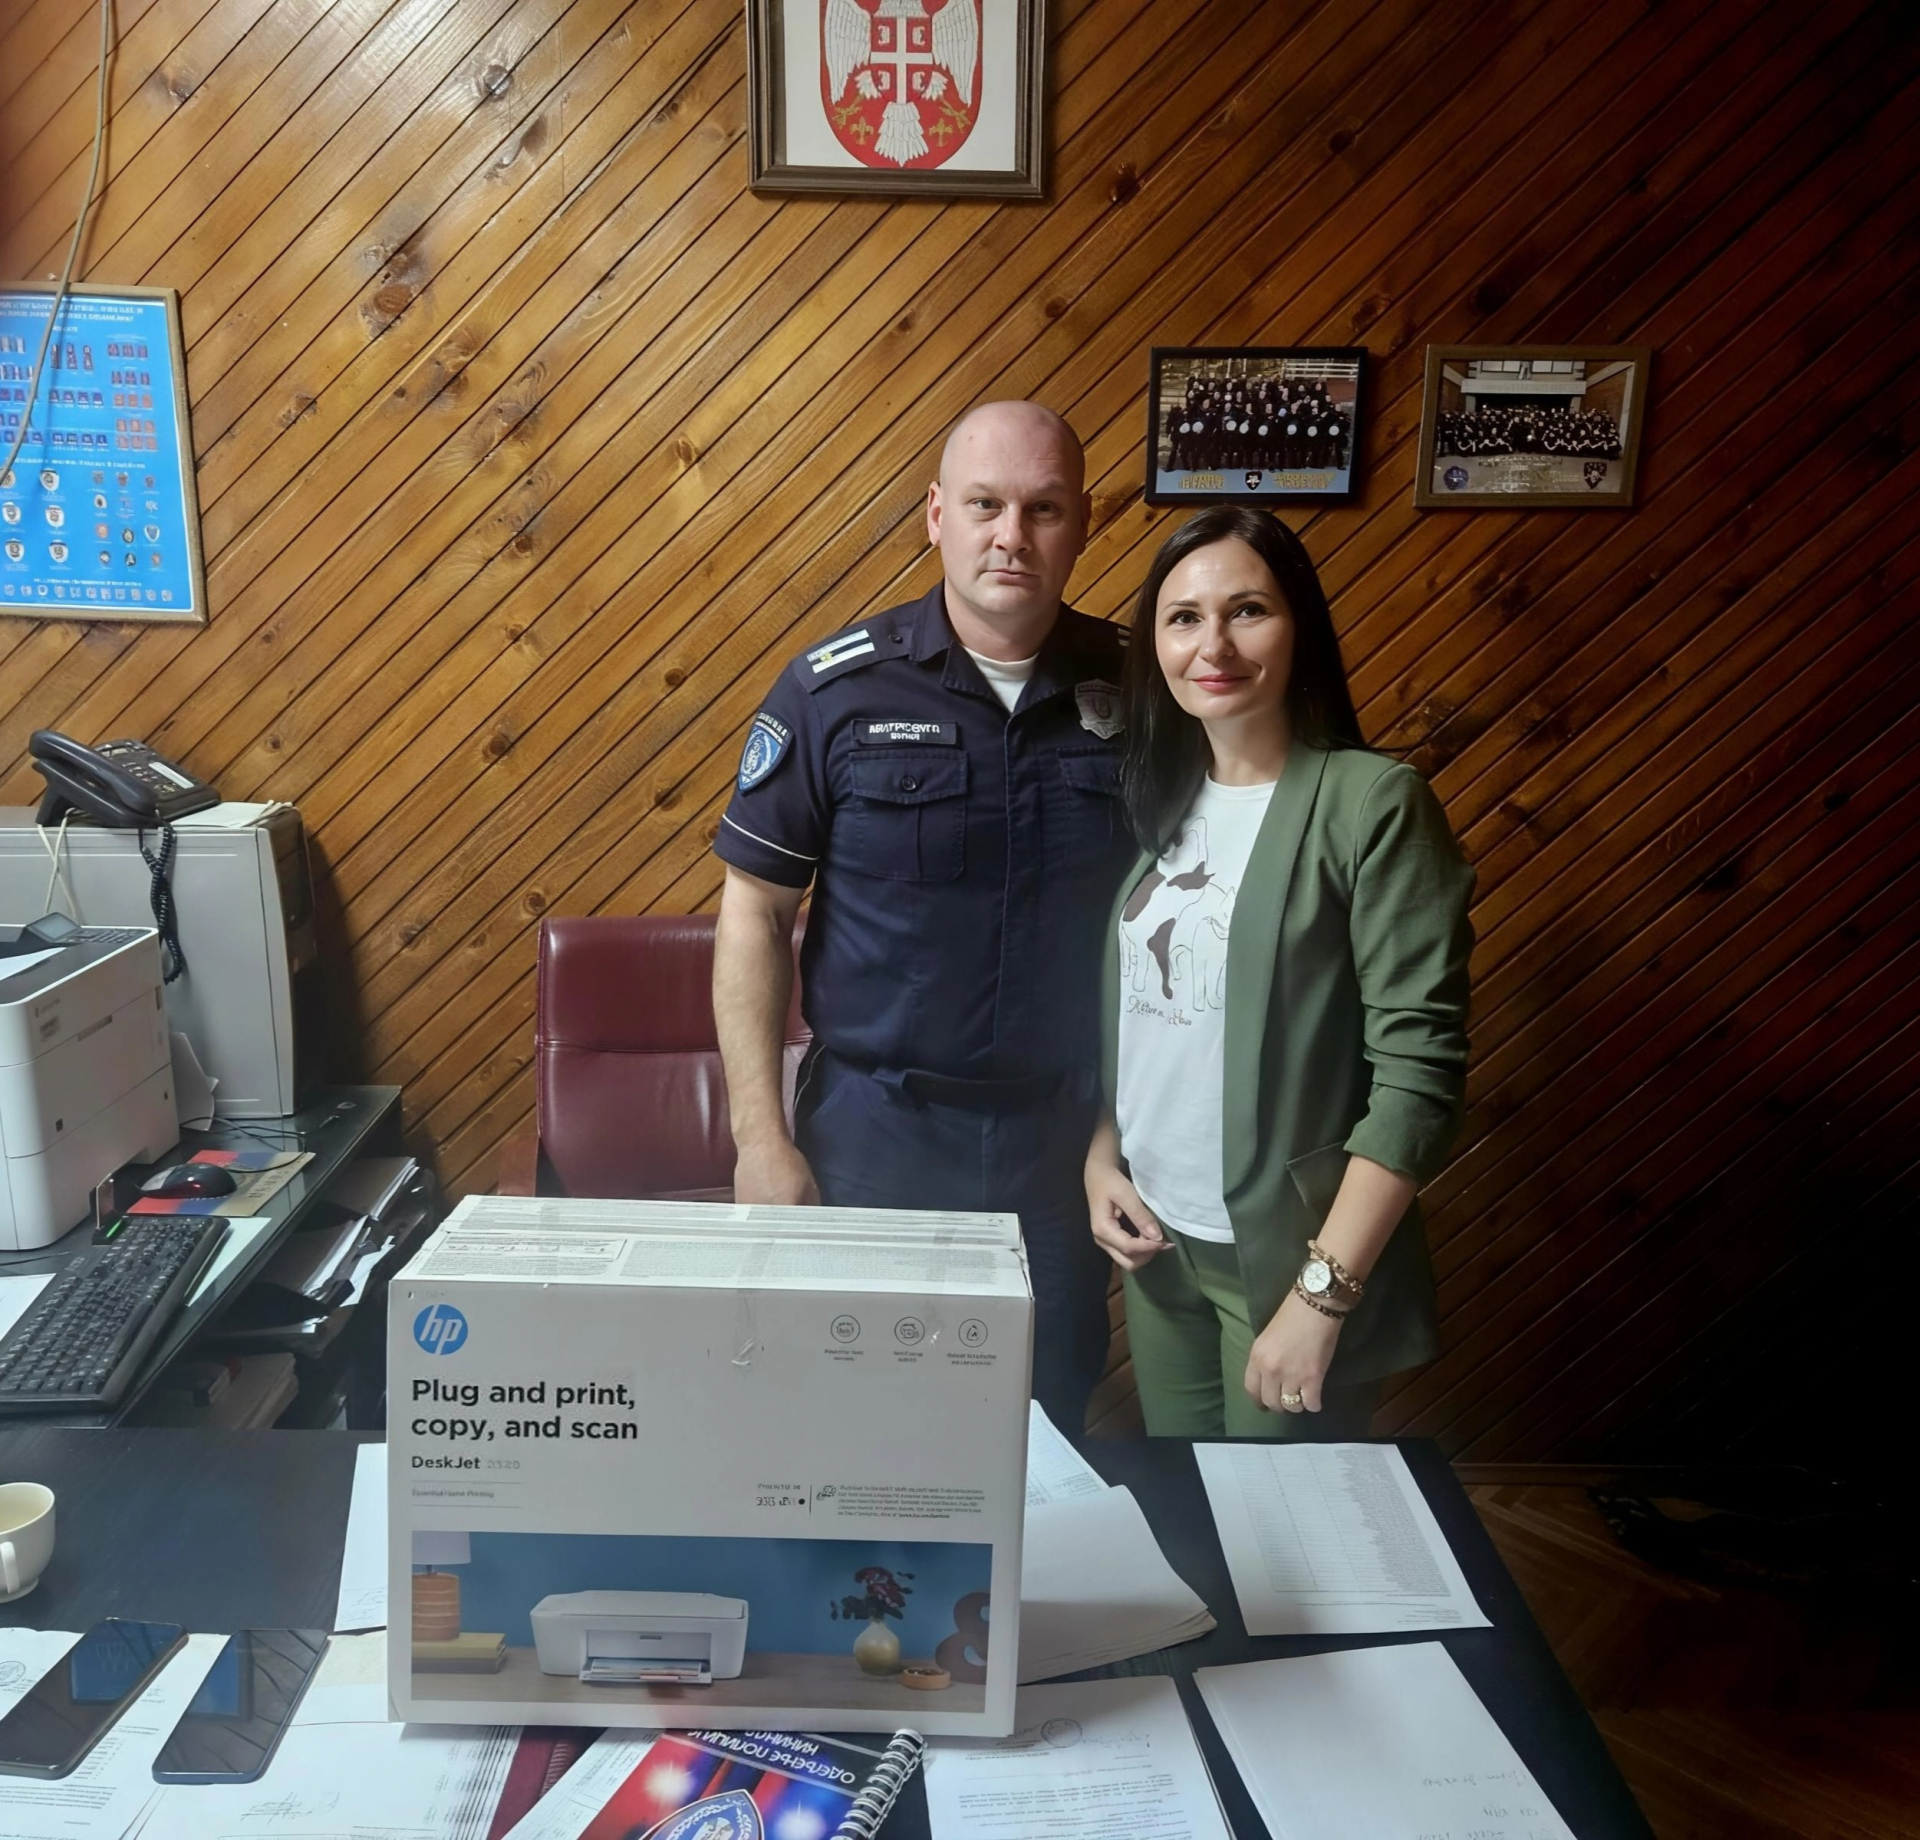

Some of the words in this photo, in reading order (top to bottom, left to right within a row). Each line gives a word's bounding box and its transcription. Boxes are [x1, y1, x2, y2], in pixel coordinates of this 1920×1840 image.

[417, 1304, 465, 1355] hp
[412, 1379, 479, 1407] Plug
[489, 1381, 545, 1404] and
[556, 1382, 635, 1410] print,
[411, 1417, 495, 1442] copy,
[505, 1416, 561, 1439] and
[570, 1419, 638, 1440] scan
[411, 1455, 481, 1470] DeskJet
